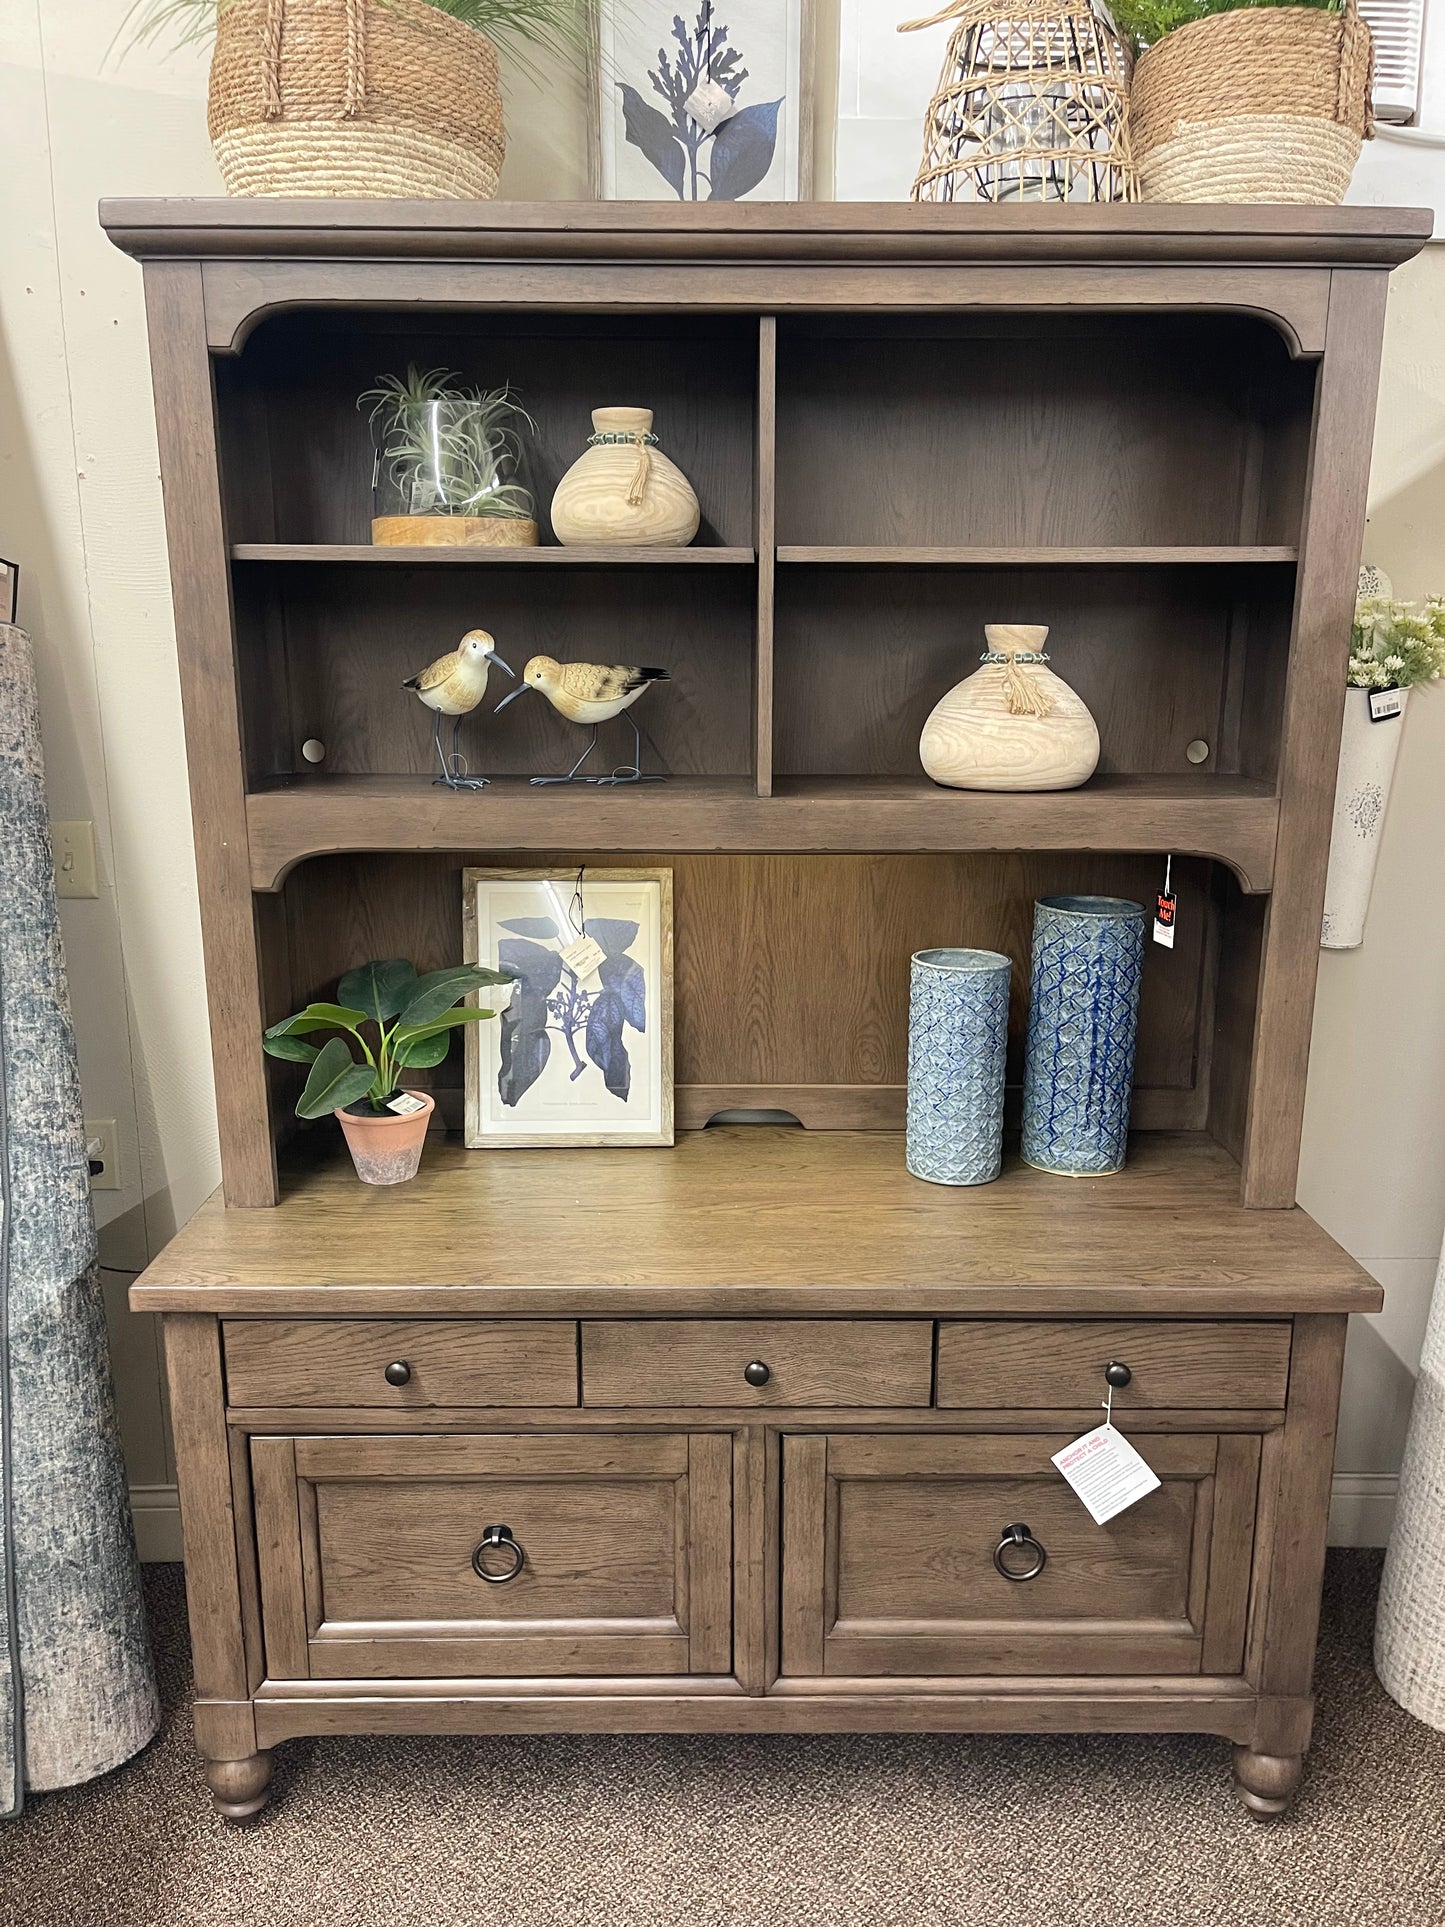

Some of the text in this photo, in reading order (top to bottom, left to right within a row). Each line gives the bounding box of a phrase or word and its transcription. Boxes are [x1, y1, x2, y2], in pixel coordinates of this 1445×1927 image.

[1158, 895, 1175, 910] Touch
[1159, 908, 1172, 922] Me!
[1059, 1448, 1082, 1465] ANCHOR
[1088, 1436, 1100, 1446] AND
[1063, 1452, 1087, 1470] PROTECT
[1092, 1438, 1109, 1450] CHILD
